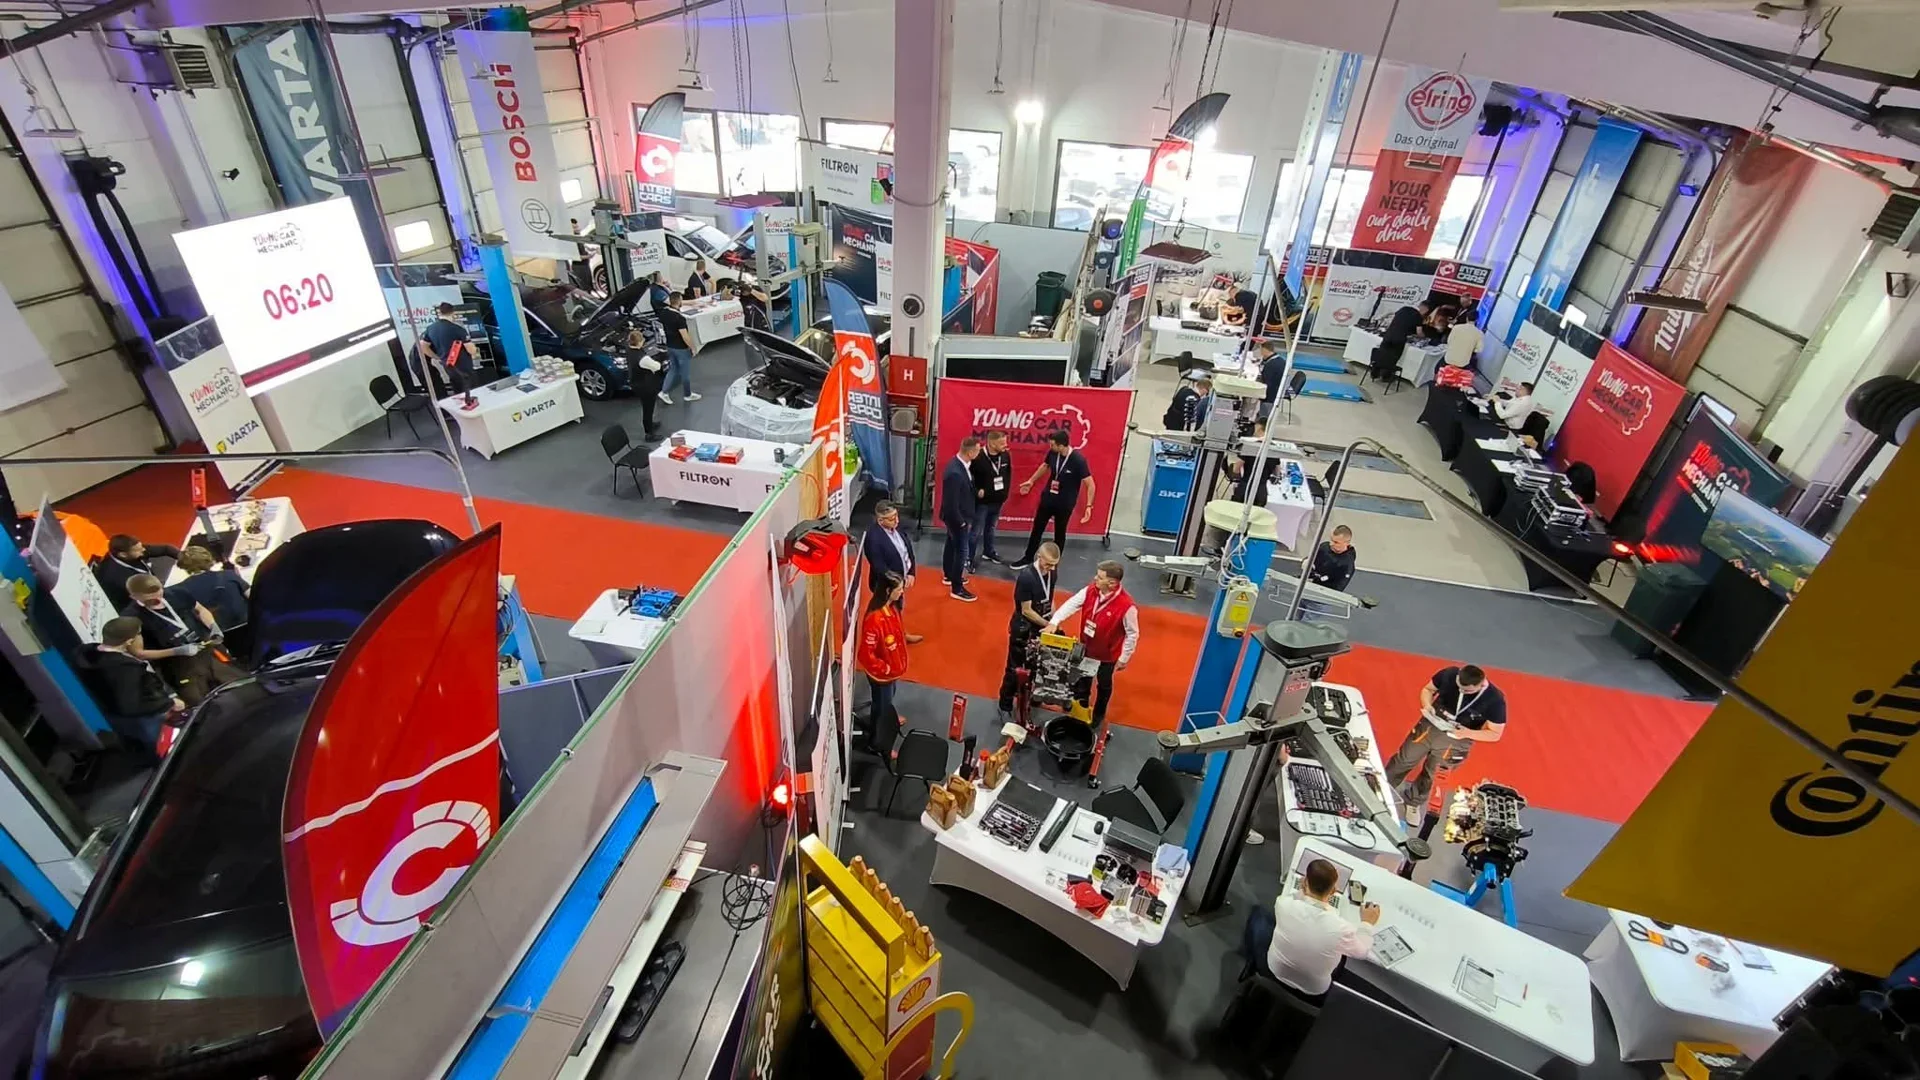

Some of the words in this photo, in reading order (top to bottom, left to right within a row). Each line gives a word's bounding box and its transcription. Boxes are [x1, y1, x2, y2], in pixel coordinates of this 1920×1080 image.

[1410, 88, 1472, 113] elring
[1394, 133, 1414, 144] Das
[1415, 135, 1459, 150] Original
[821, 158, 858, 175] FILTRON
[639, 182, 672, 196] INTER
[1389, 180, 1431, 198] YOUR
[639, 192, 671, 205] CARS
[1379, 195, 1430, 213] NEEDS
[1366, 213, 1392, 227] our
[1392, 207, 1431, 231] daily
[253, 231, 279, 246] YOUNG
[279, 230, 295, 240] CAR
[257, 238, 299, 254] MECHANIC
[644, 247, 658, 255] CAR
[1457, 273, 1486, 283] CARS
[1459, 265, 1488, 276] INTER
[263, 273, 333, 320] 06:20
[214, 375, 231, 389] CAR
[903, 369, 913, 381] H
[1597, 368, 1629, 397] YOUNG
[196, 383, 235, 412] MECHANIC
[523, 399, 556, 416] VARTA
[972, 408, 1034, 429] YOUNG
[1034, 418, 1072, 430] CAR
[227, 420, 259, 445] VARTA
[679, 471, 731, 487] FILTRON
[1681, 458, 1720, 507] MECHAN
[1158, 490, 1185, 498] SKF
